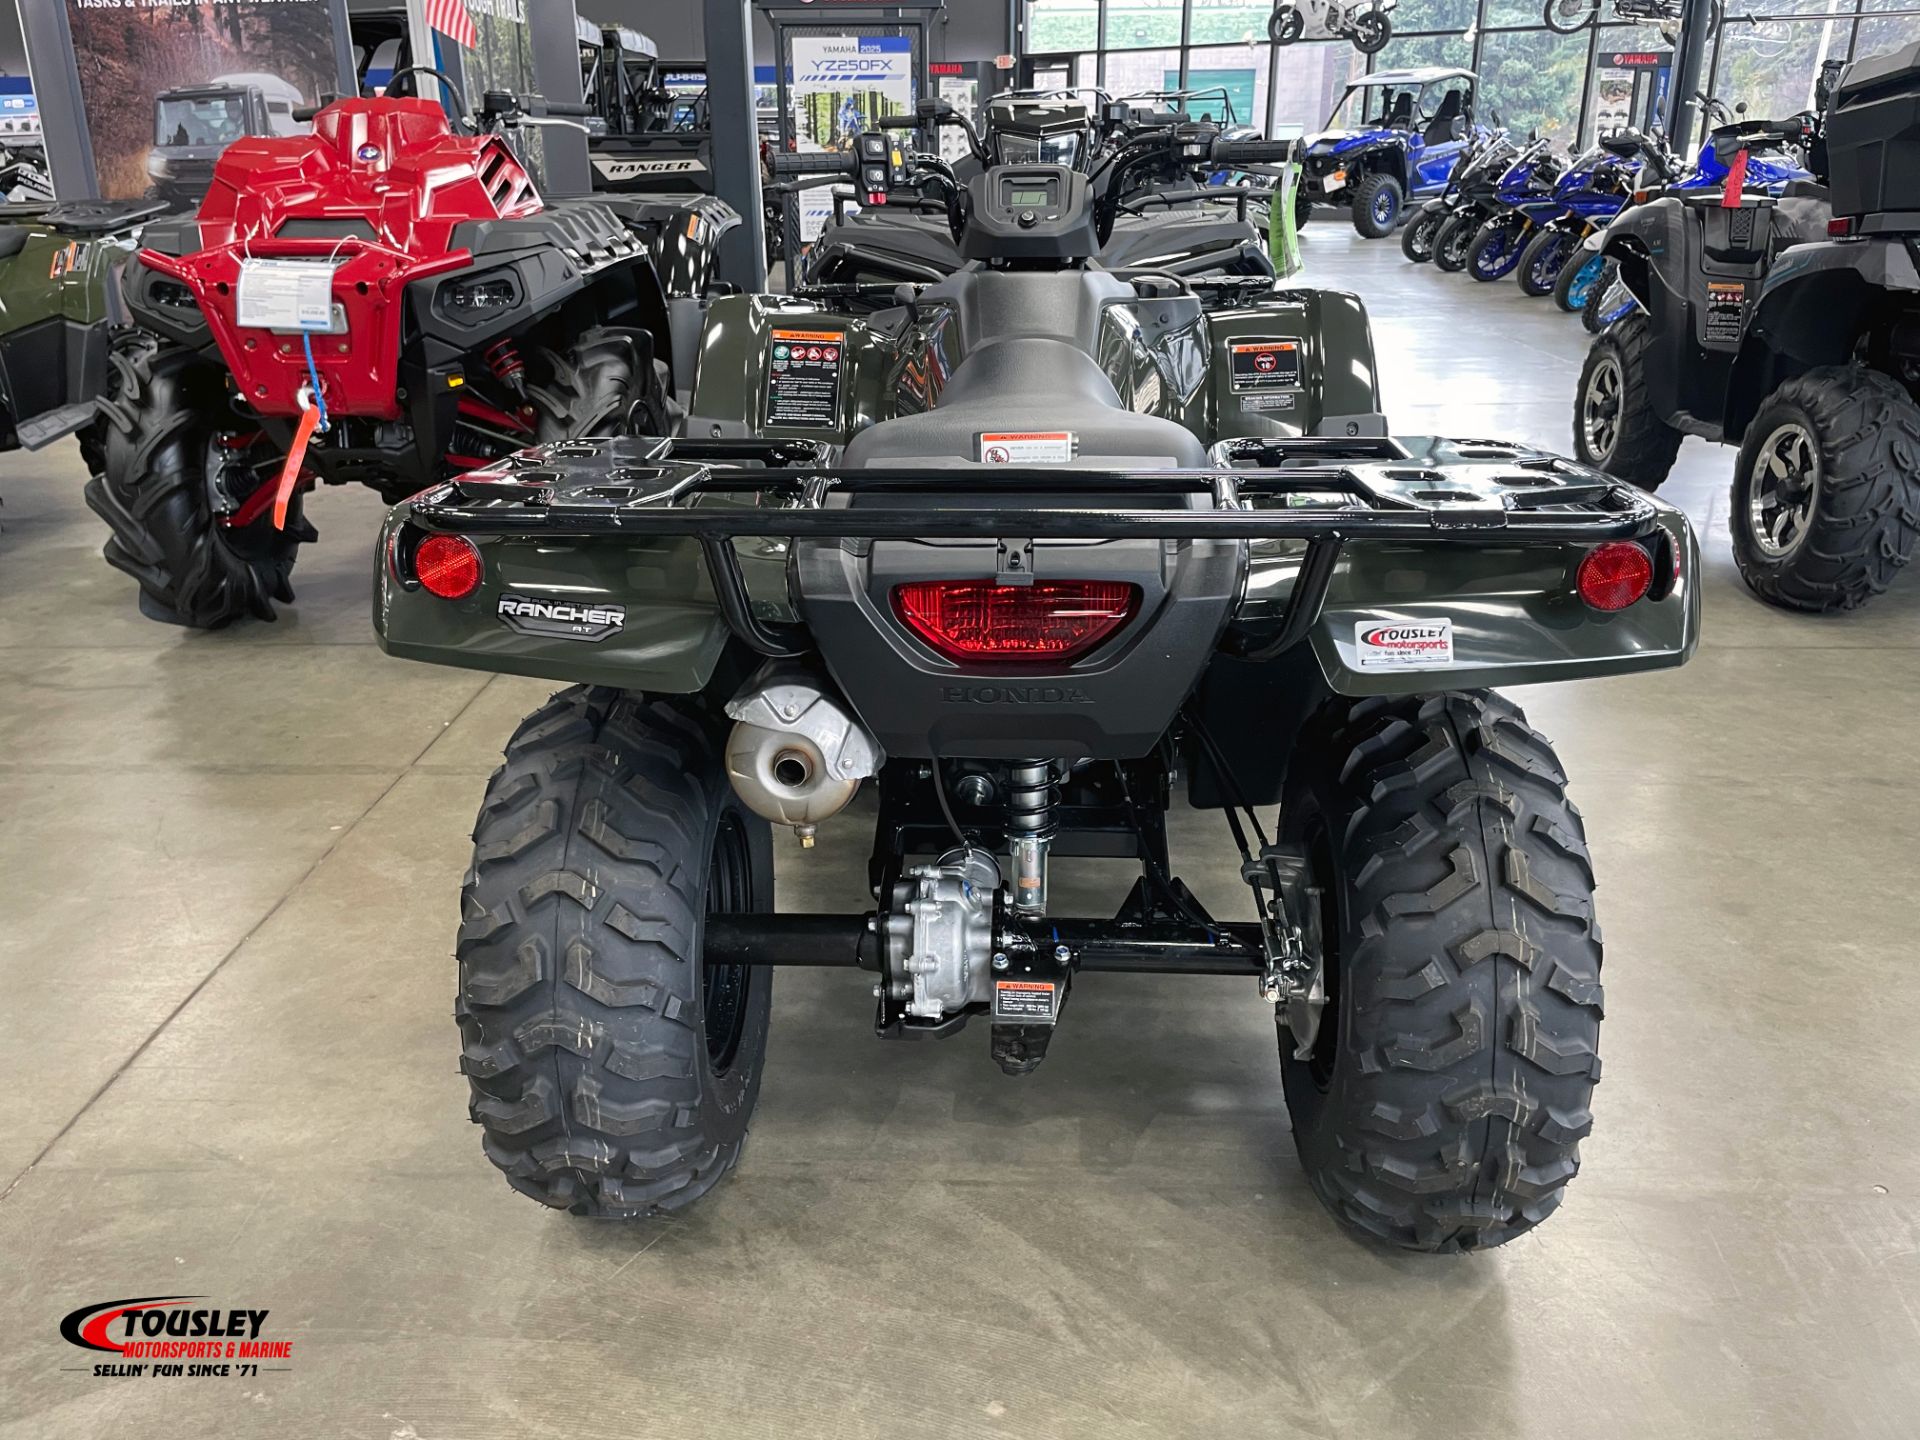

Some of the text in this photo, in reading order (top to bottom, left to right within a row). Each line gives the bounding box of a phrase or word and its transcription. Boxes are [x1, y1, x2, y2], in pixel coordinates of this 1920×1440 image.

[860, 45, 881, 53] 2025
[1624, 54, 1658, 64] YAMAHA
[812, 59, 893, 71] YZ250FX
[930, 64, 962, 75] YAMAHA
[609, 162, 691, 173] RANGER
[498, 600, 625, 627] RANCHER
[572, 625, 592, 633] AT
[1379, 626, 1446, 641] TOUSLEY
[1386, 640, 1448, 651] motorsports
[938, 687, 1096, 704] HONDA
